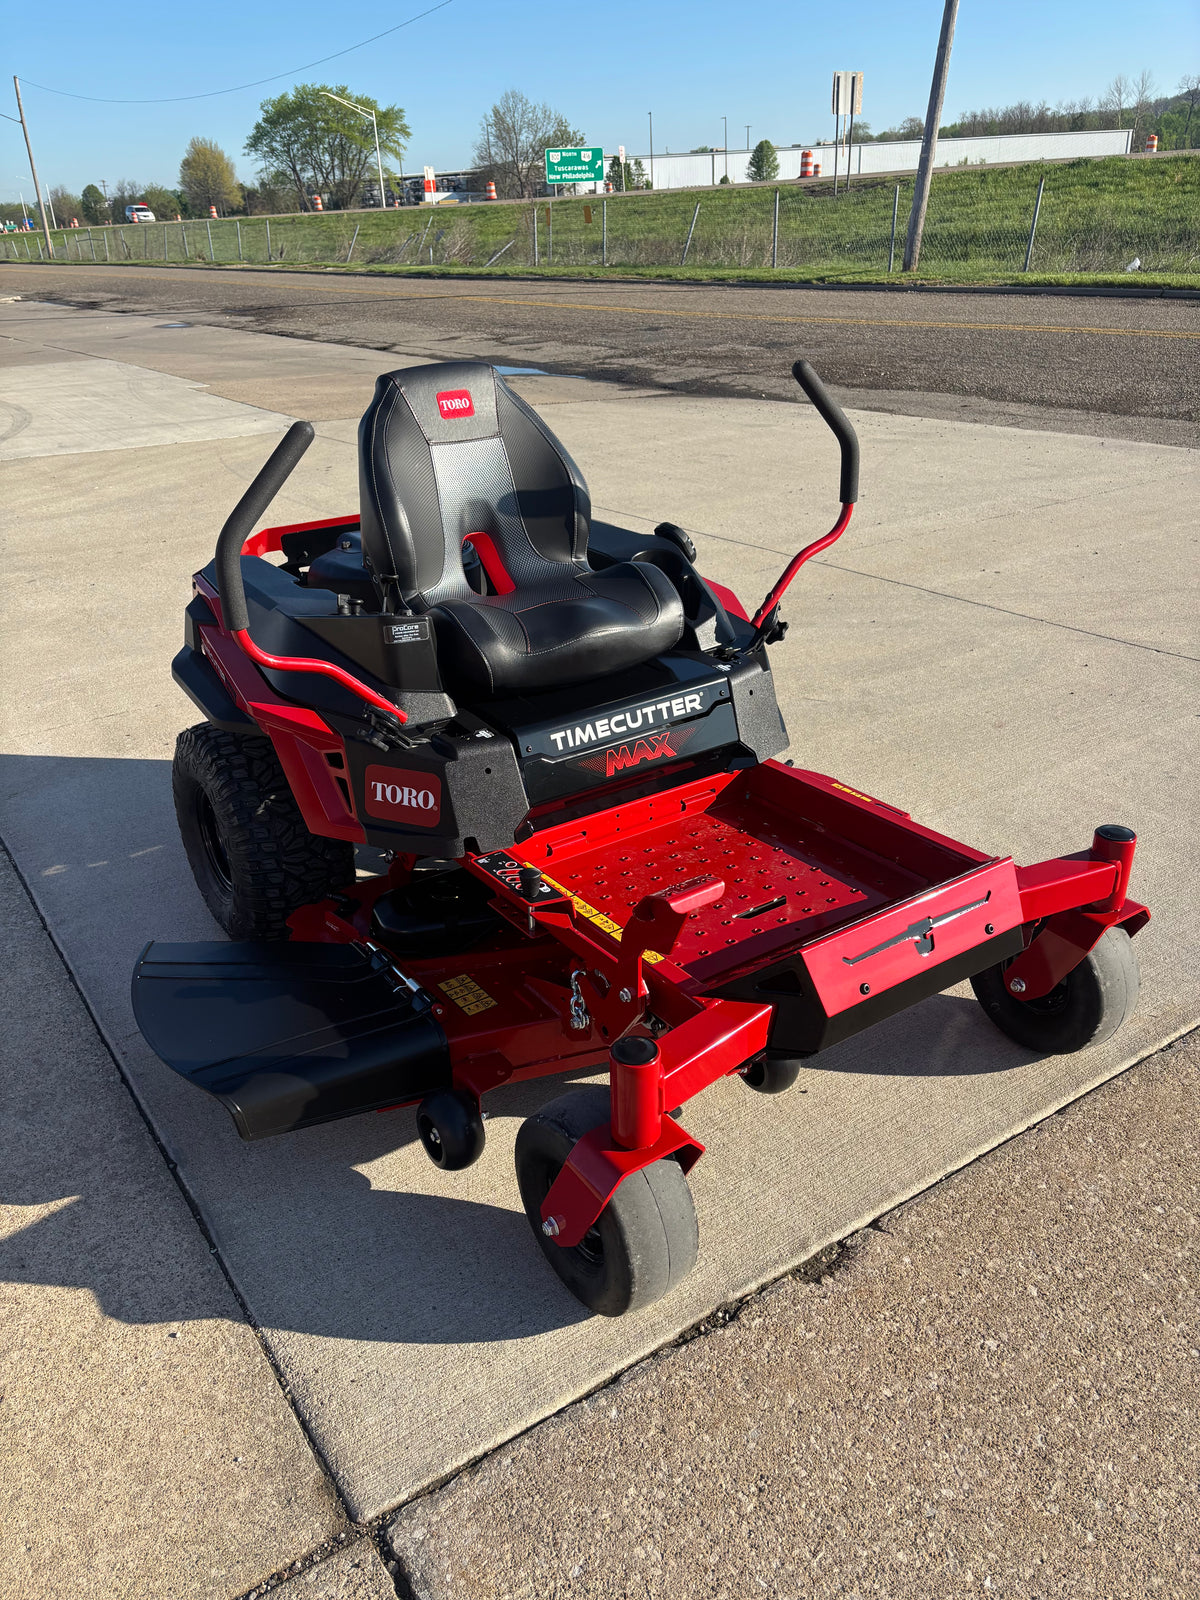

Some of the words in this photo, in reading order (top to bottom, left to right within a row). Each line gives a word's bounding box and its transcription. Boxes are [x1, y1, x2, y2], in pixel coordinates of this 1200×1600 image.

[562, 172, 595, 180] Philadelphia
[440, 398, 470, 411] TORO
[550, 693, 704, 751] TIMECUTTER
[605, 731, 677, 777] MAX
[371, 781, 435, 810] TORO
